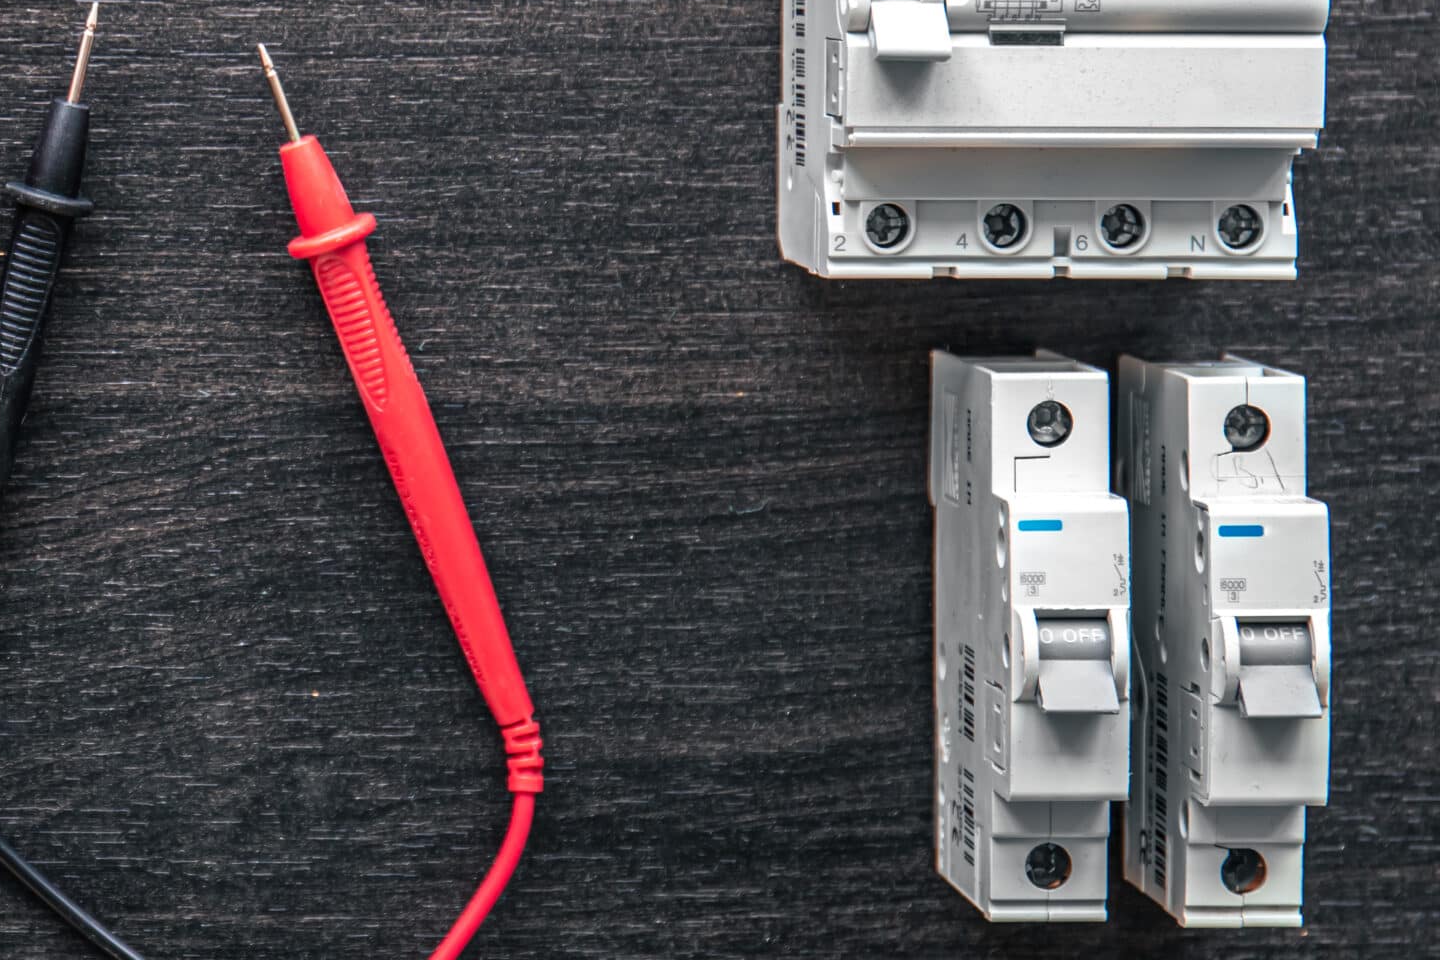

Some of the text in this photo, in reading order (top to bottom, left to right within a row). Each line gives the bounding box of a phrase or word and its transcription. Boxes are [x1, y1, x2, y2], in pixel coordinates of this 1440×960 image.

[833, 234, 846, 252] 2
[955, 233, 969, 250] 4
[1075, 234, 1089, 252] 6
[1191, 234, 1205, 252] N
[1062, 627, 1106, 644] OFF
[1263, 626, 1305, 641] OFF
